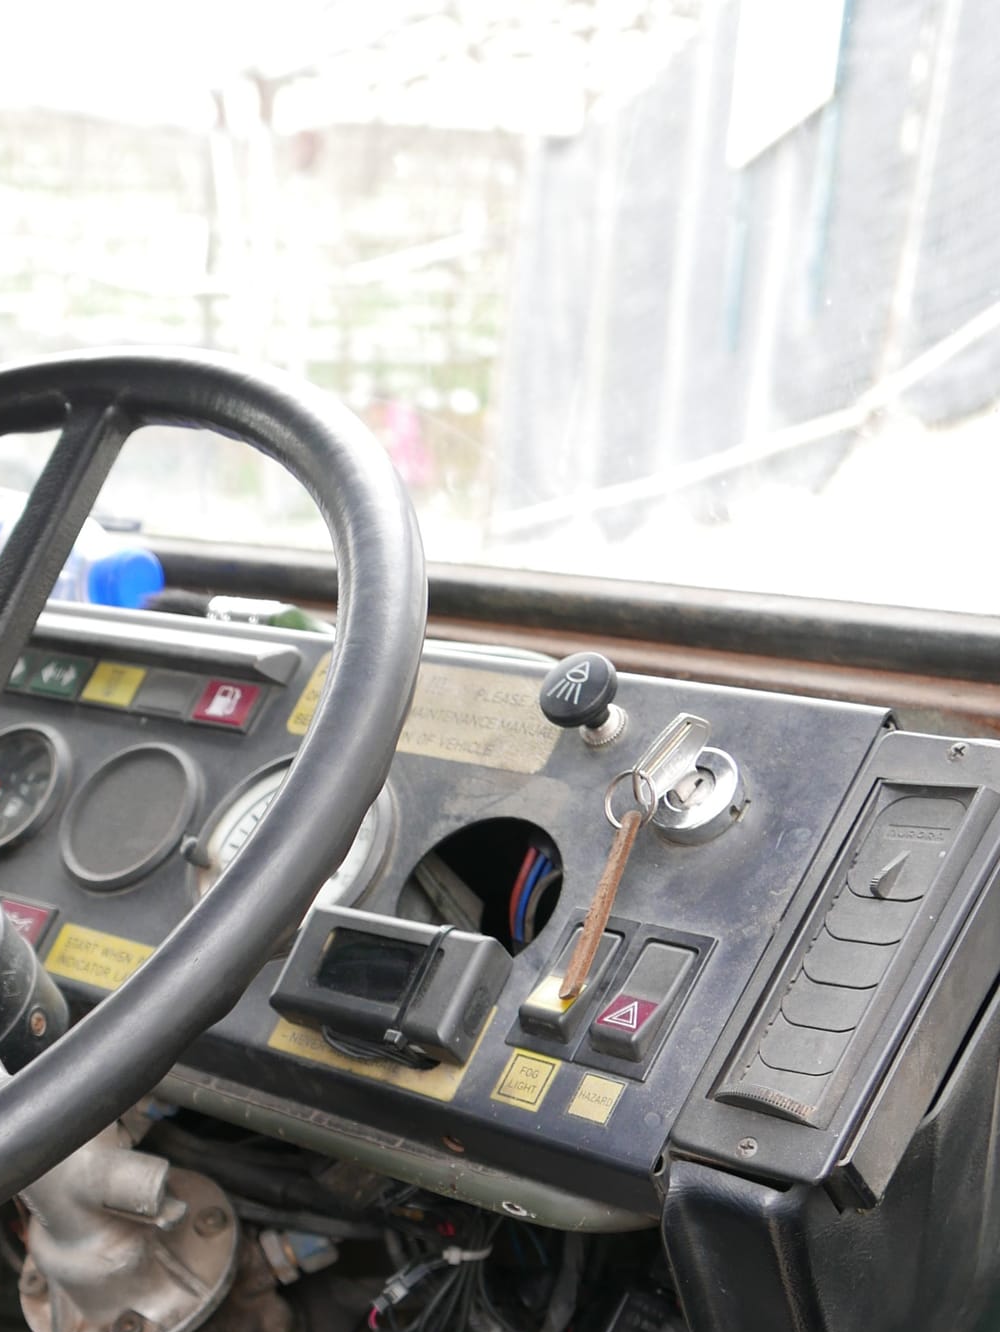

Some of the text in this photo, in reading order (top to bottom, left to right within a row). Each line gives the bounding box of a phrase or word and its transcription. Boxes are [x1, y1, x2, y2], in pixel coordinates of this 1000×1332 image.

[519, 1065, 540, 1080] FOG
[507, 1080, 538, 1095] LIGHT
[579, 1089, 614, 1108] HAZARD
